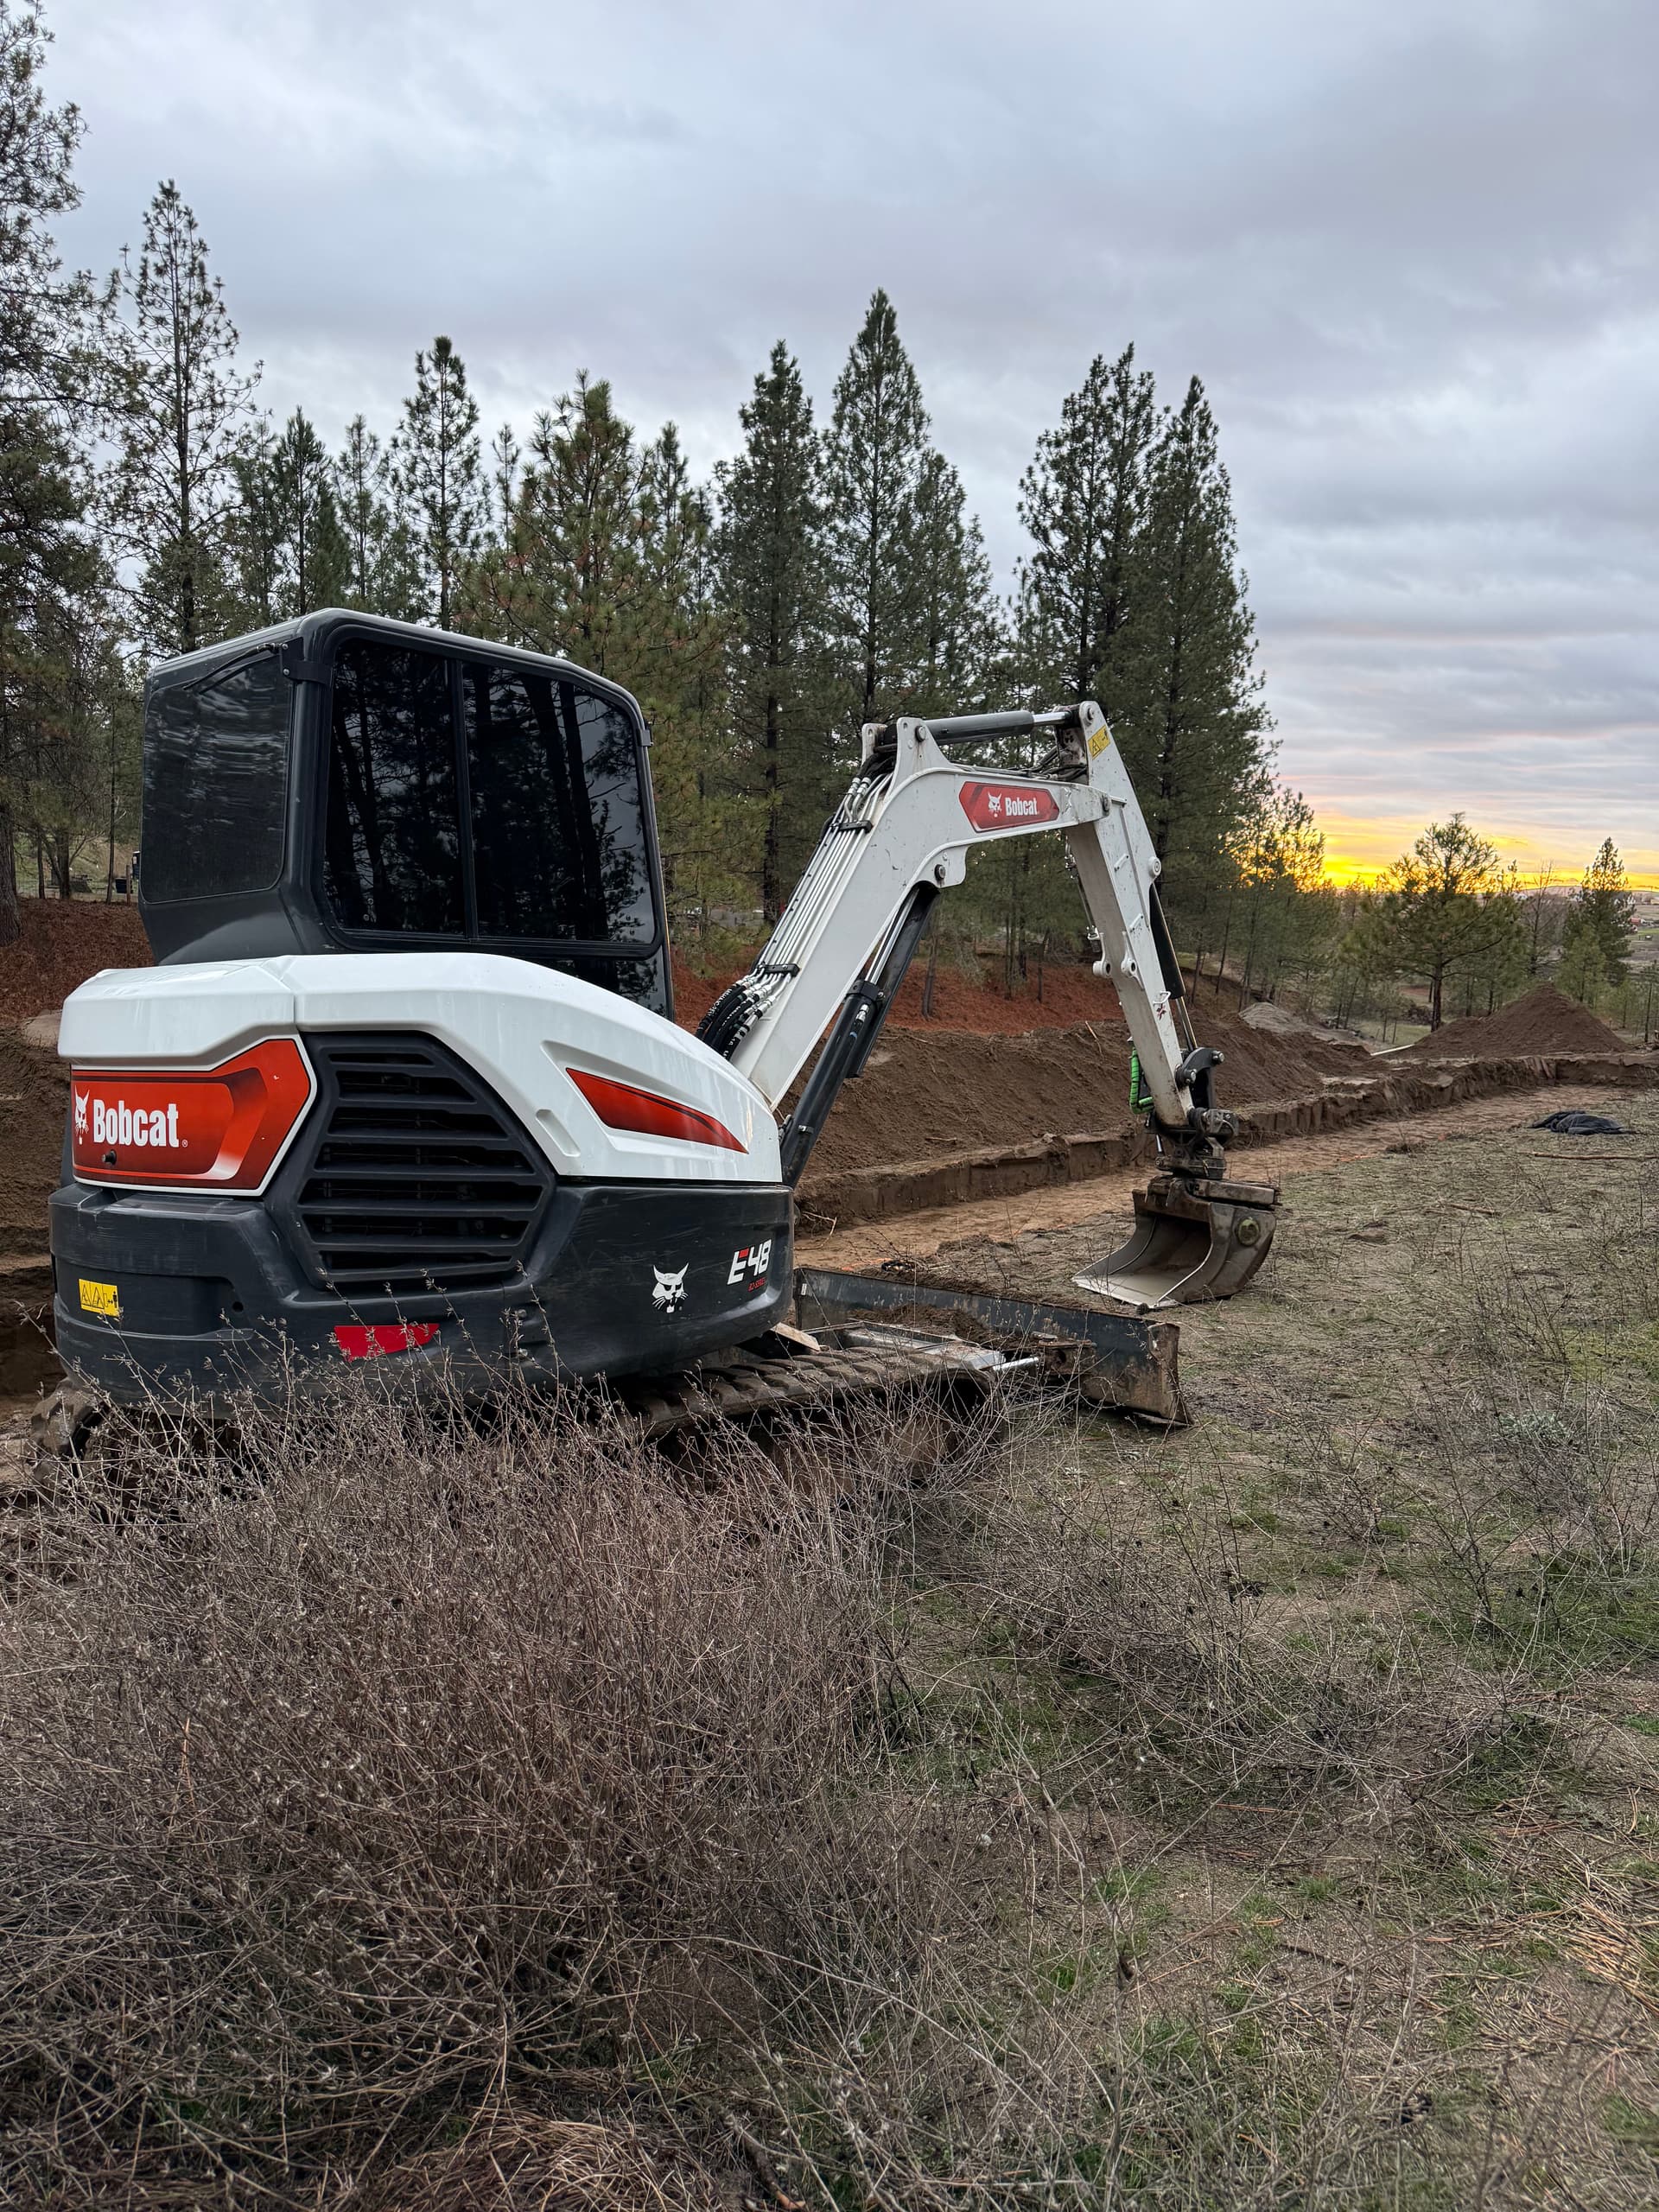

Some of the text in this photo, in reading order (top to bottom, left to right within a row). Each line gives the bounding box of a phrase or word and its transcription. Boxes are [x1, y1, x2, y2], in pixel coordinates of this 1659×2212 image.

[1005, 797, 1039, 817] Bobcat
[92, 1098, 180, 1147] Bobcat
[727, 1239, 772, 1285] E48
